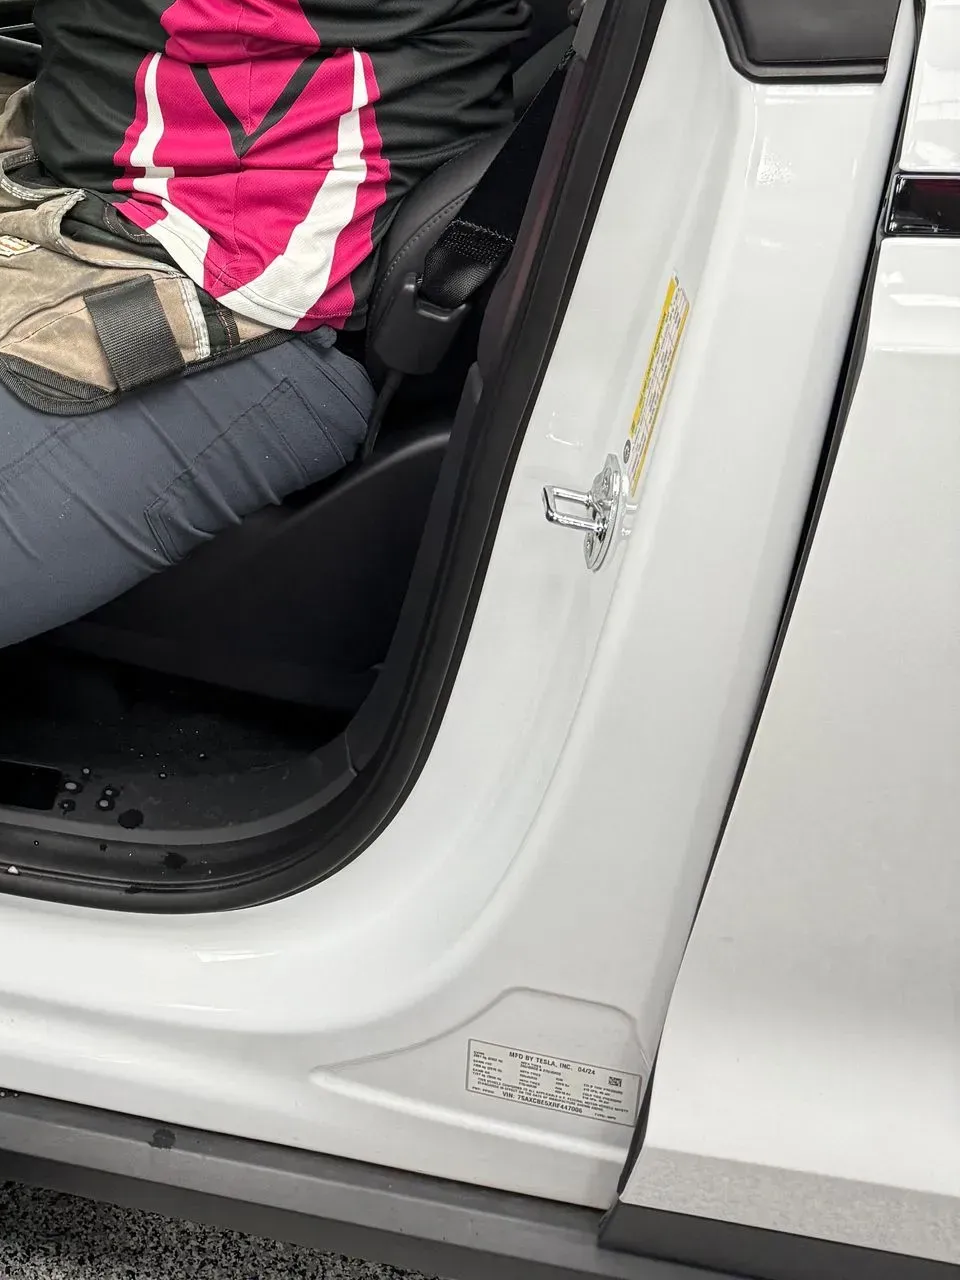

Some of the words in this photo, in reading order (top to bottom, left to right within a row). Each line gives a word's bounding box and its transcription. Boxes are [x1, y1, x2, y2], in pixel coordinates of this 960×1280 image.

[509, 1051, 523, 1060] MFD
[577, 1066, 596, 1075] 04/24
[502, 1091, 515, 1099] VIN:
